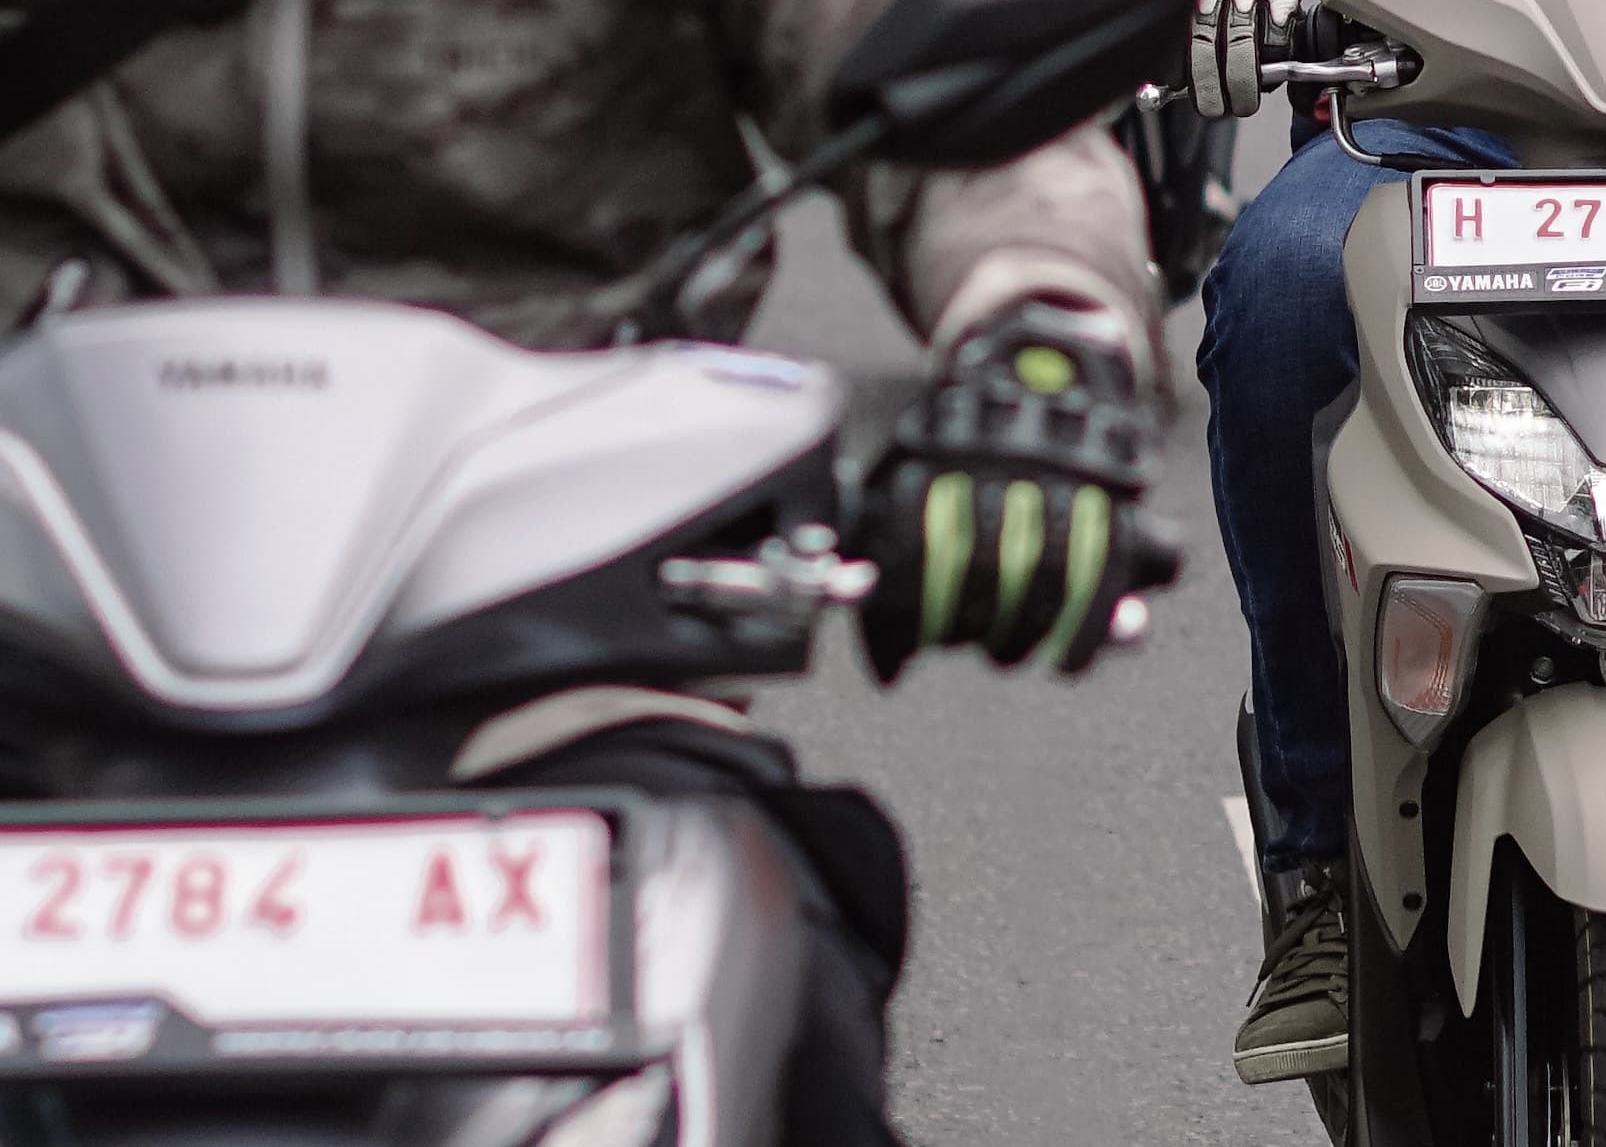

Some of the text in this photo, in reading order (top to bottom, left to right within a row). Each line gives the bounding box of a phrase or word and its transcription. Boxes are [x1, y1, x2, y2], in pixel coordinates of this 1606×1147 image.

[1454, 197, 1484, 239] H
[1448, 273, 1535, 291] YAMAHA
[25, 841, 551, 941] 2784 AX
